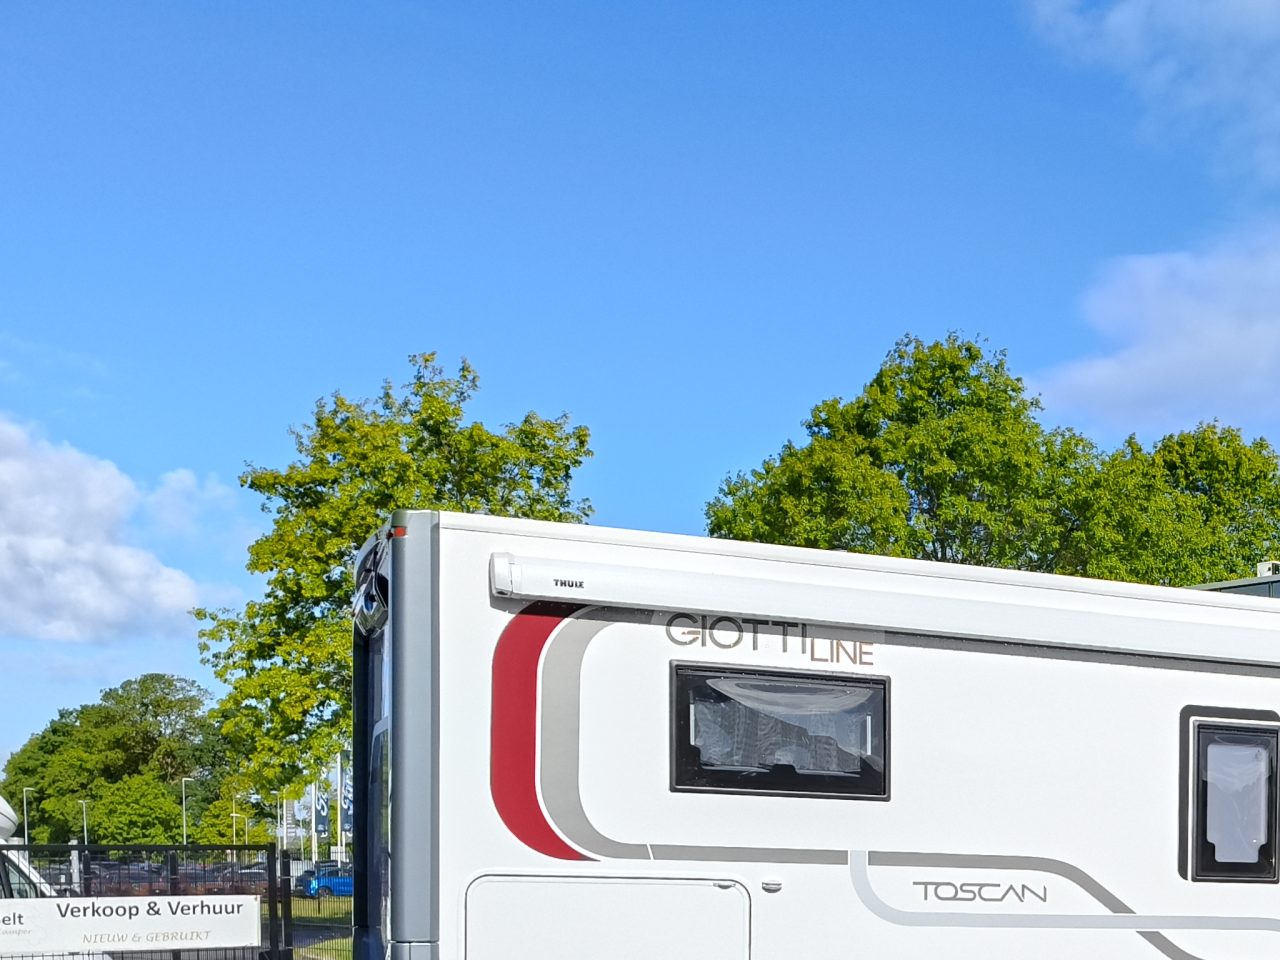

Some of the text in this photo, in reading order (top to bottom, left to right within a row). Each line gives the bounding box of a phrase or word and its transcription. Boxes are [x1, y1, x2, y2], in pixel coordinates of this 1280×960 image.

[552, 578, 585, 589] THULE
[912, 881, 1047, 903] TOSCAN
[56, 900, 244, 920] Verkoop & Verhuur
[0, 912, 24, 925] elt
[0, 929, 32, 937] amper
[83, 930, 212, 944] NIEUW & GEBRUIKT
